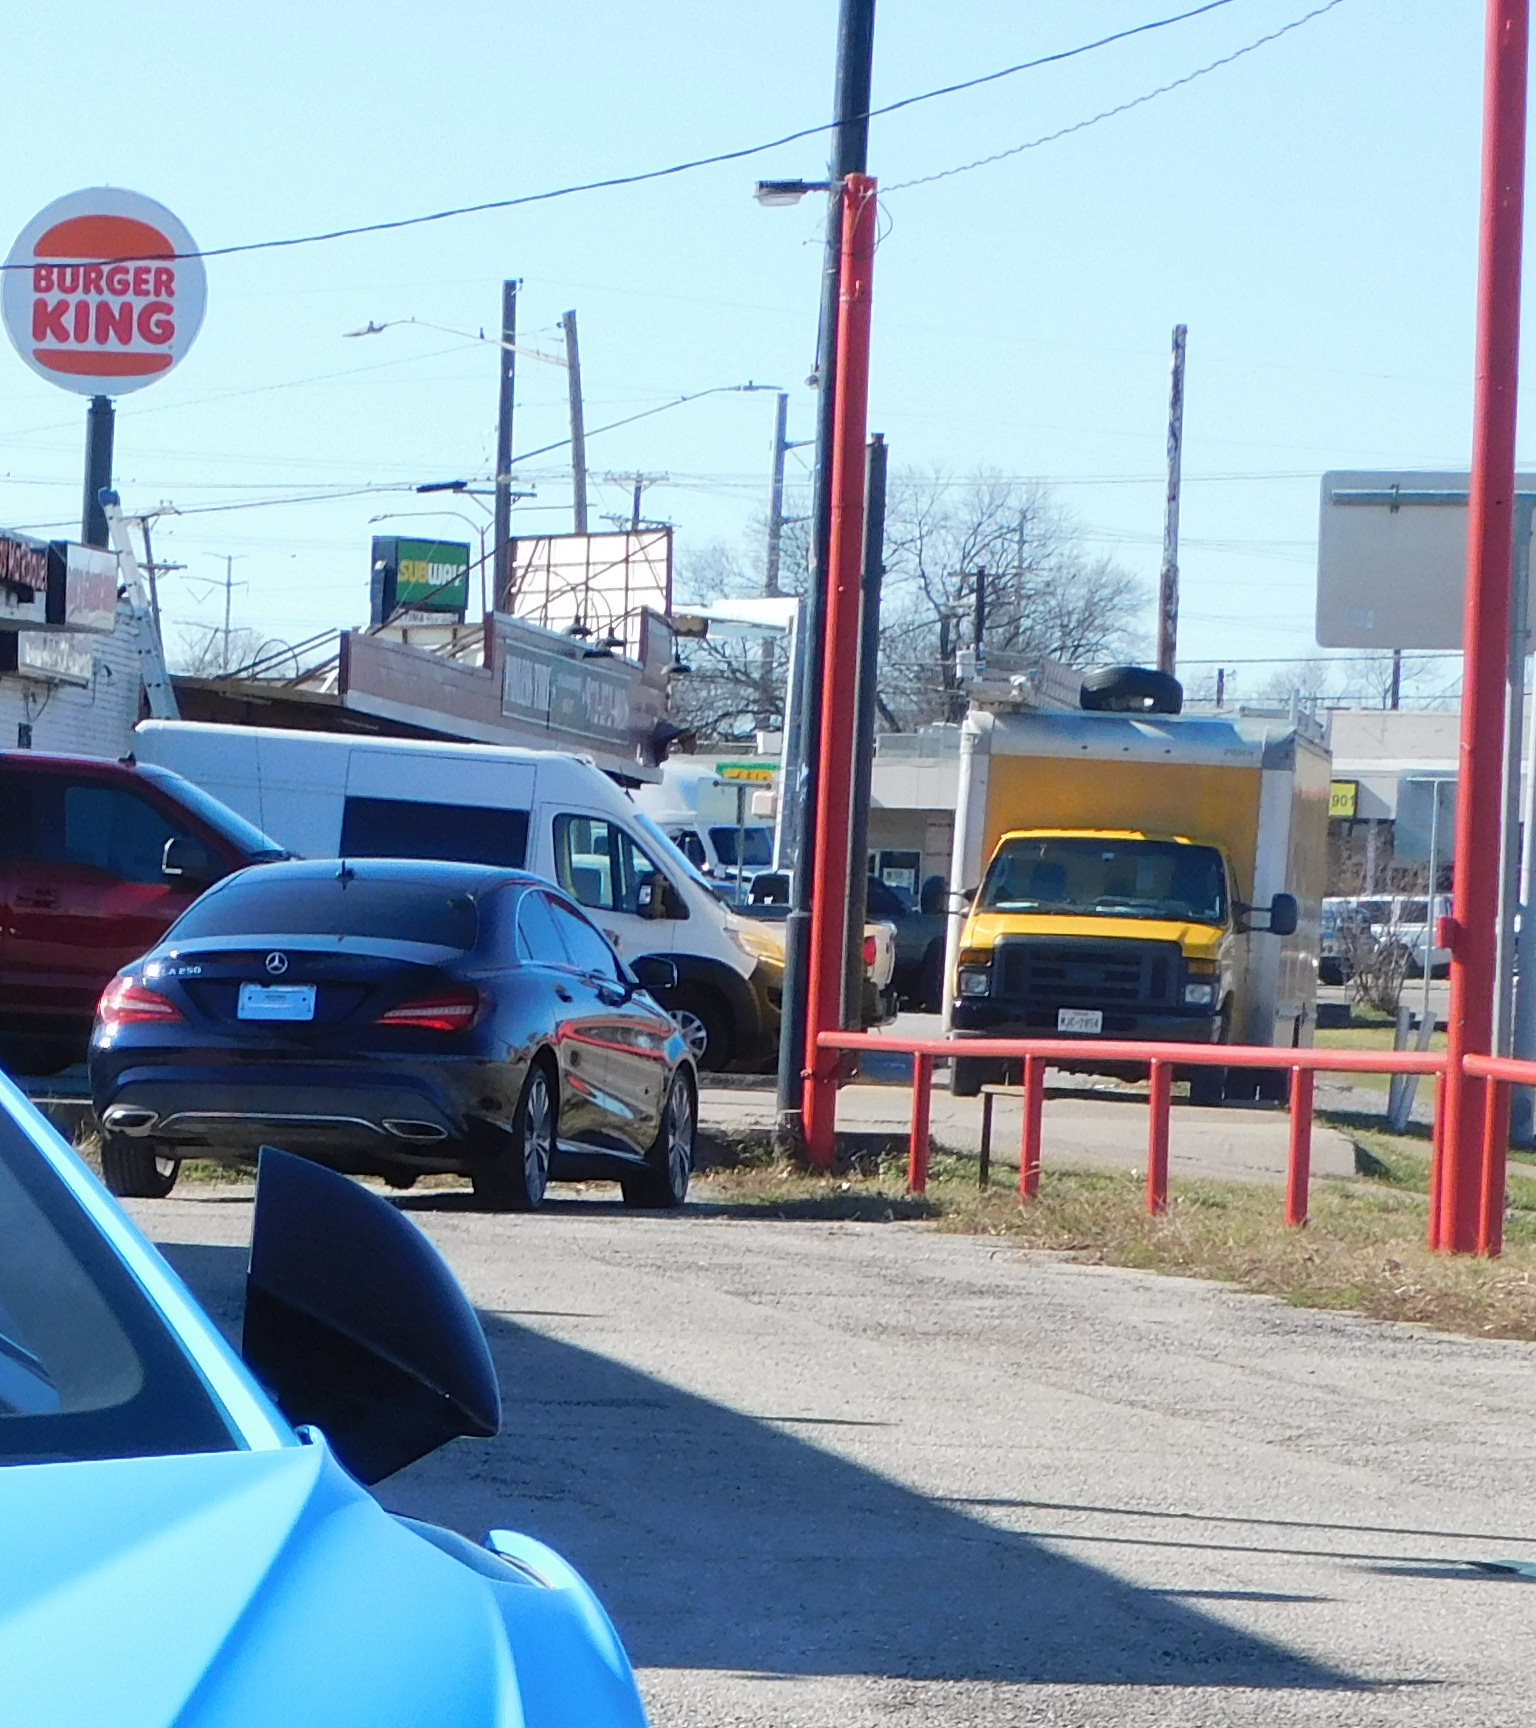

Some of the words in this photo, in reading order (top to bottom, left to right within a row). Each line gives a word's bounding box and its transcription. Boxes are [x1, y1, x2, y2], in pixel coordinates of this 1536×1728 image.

[33, 263, 176, 298] BURGER
[32, 297, 176, 346] KING
[398, 559, 467, 587] SUBWAY
